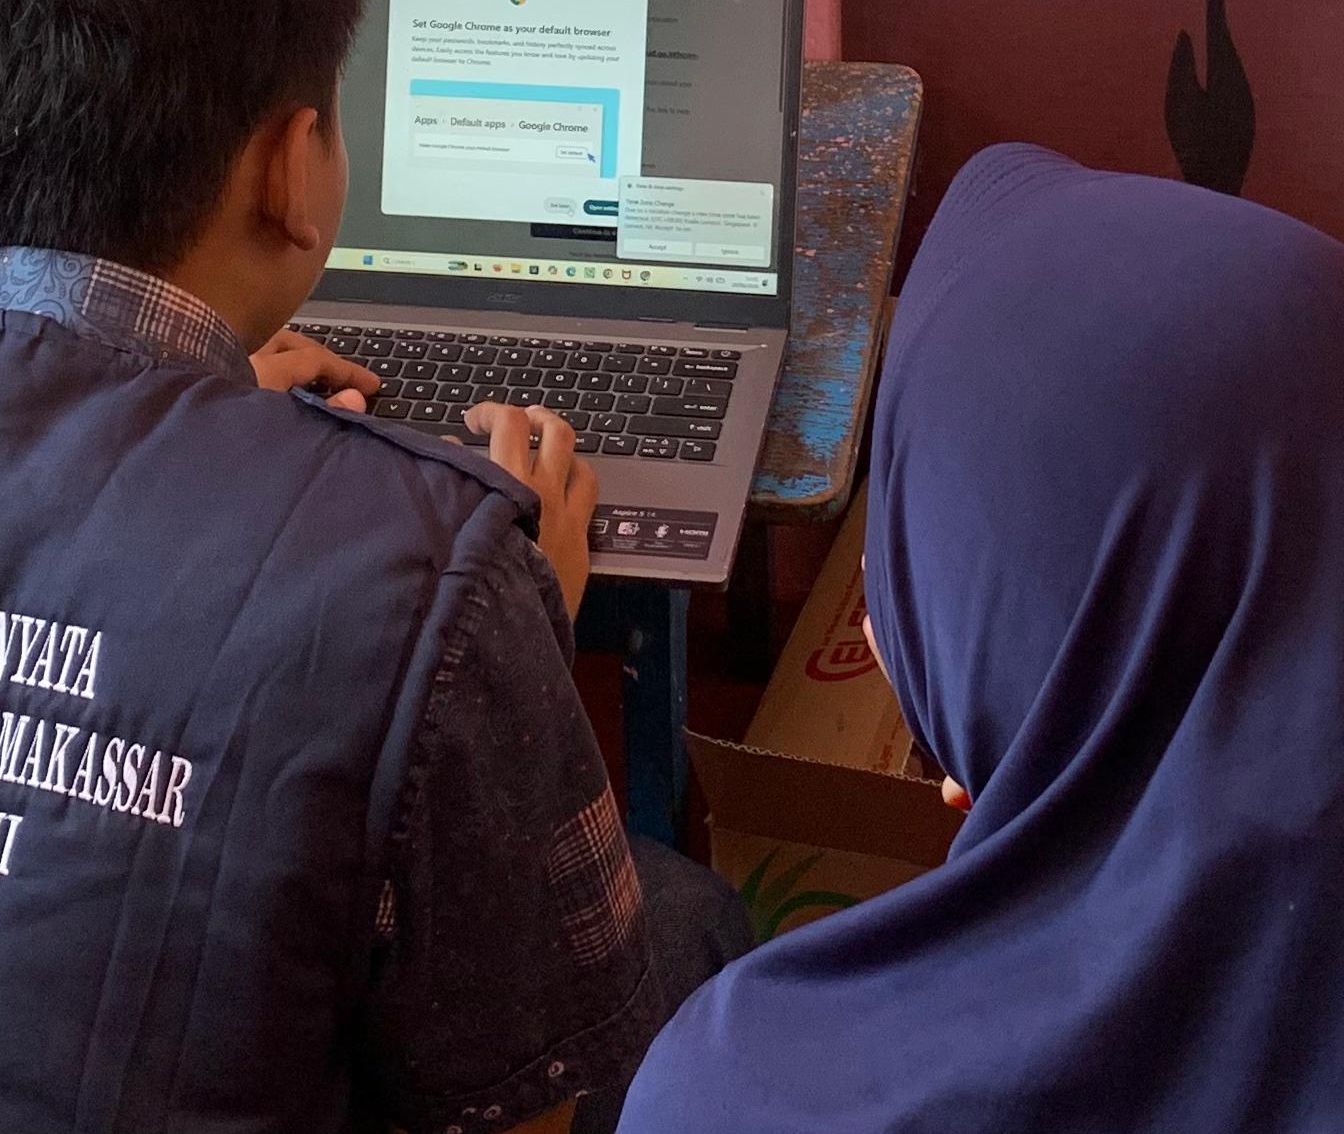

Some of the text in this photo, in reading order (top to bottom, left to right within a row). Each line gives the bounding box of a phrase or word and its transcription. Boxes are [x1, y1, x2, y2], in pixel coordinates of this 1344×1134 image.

[412, 19, 611, 37] Set Google Chrome as your default browser
[415, 116, 588, 133] Apps Default apps Google Chrome
